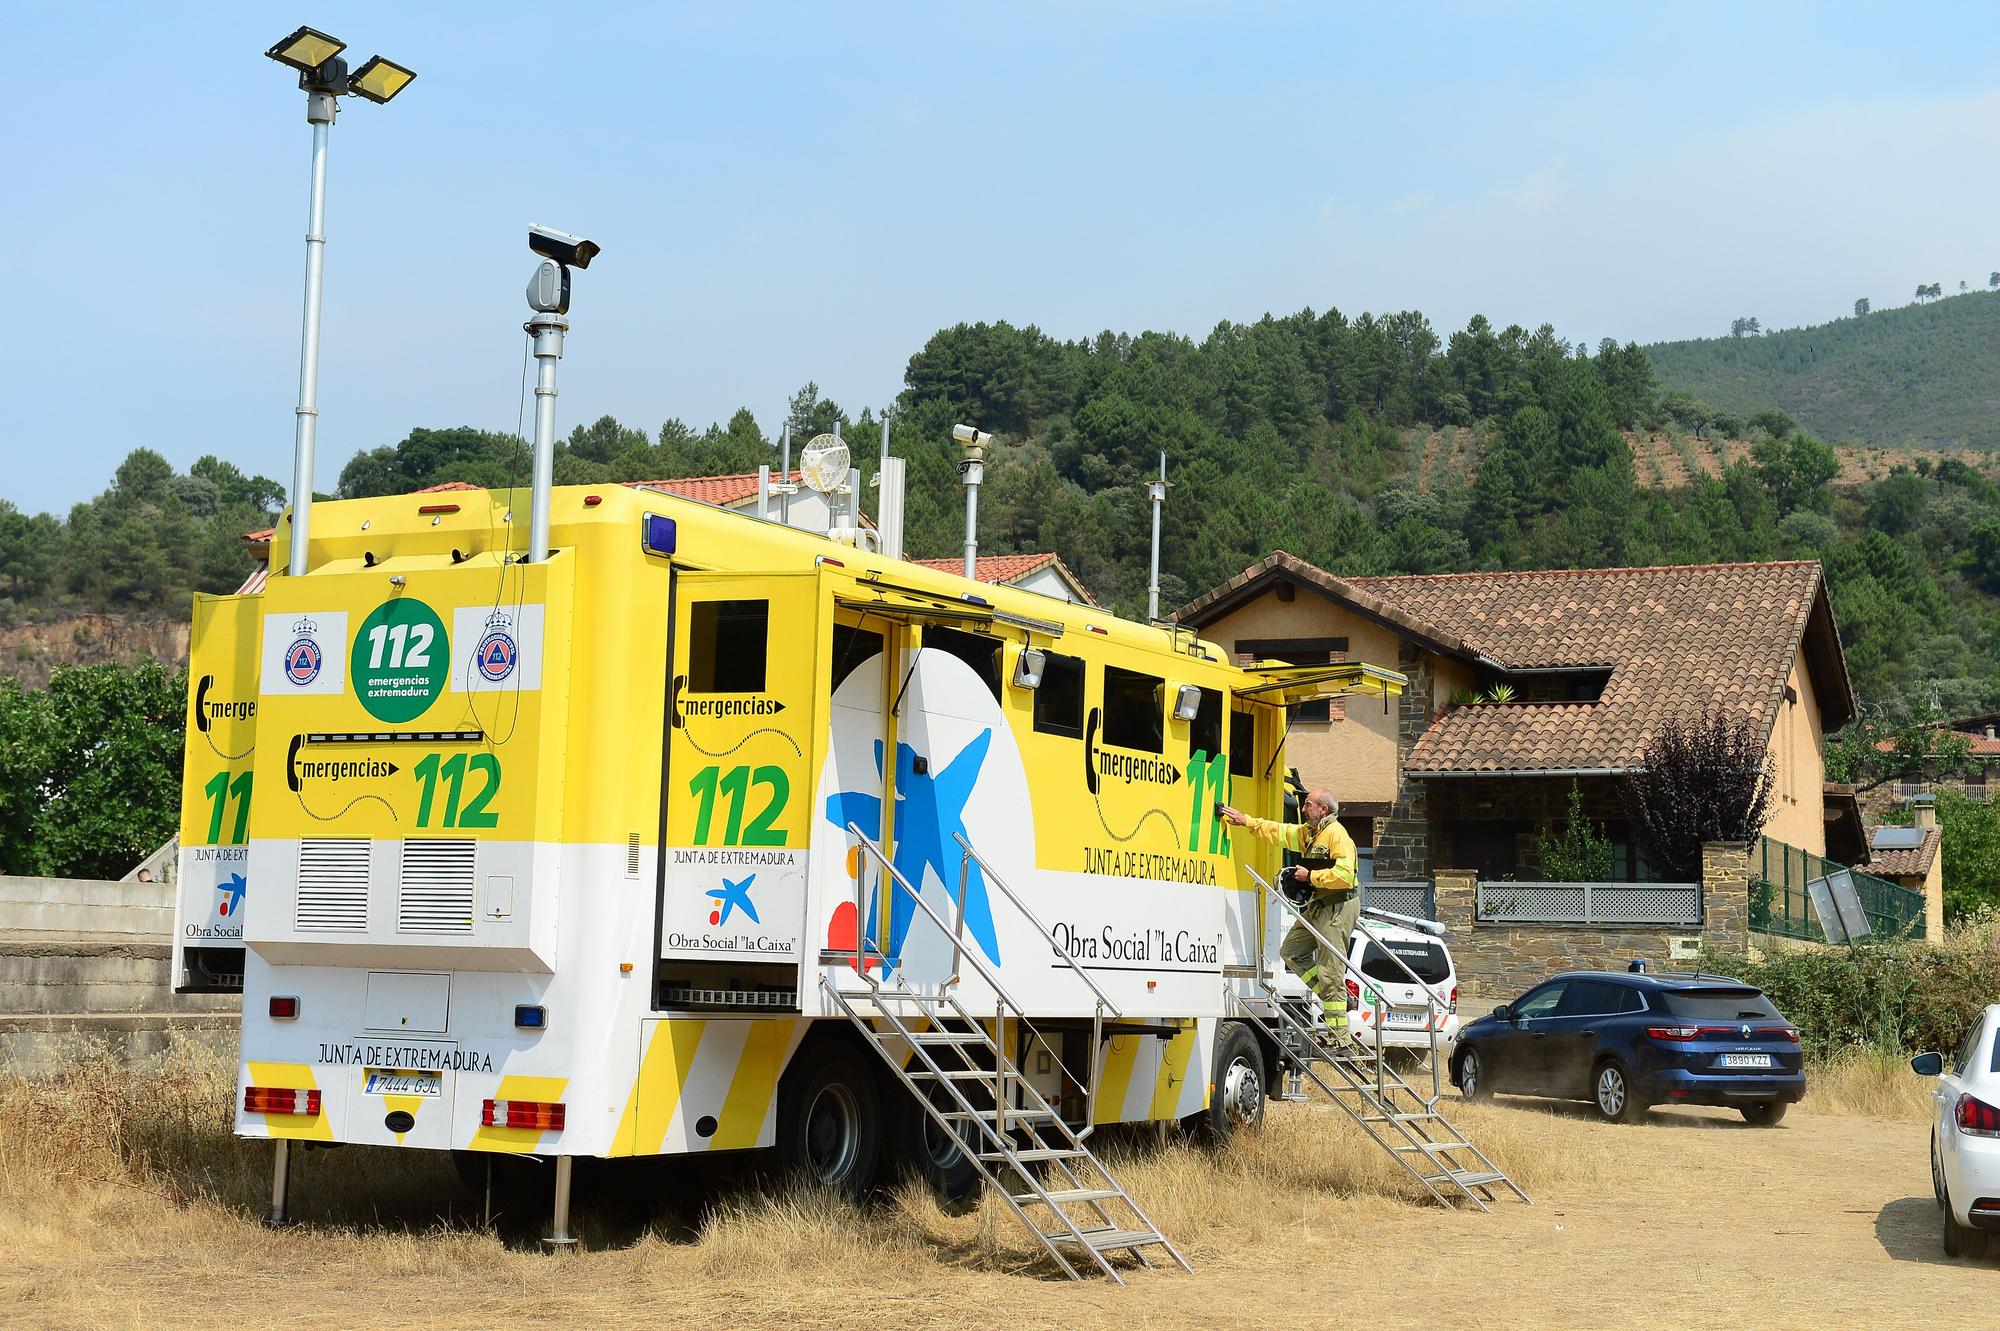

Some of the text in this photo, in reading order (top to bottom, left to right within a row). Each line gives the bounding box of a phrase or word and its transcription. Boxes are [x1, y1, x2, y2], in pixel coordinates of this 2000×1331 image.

[368, 623, 434, 668] 112
[299, 657, 308, 666] 112
[492, 652, 502, 661] 112
[368, 674, 429, 688] emergencias
[367, 686, 429, 697] extremadura
[414, 753, 502, 828] 112
[204, 771, 254, 844] 11
[688, 765, 790, 847] 112
[195, 849, 221, 861] JUNTA
[223, 849, 232, 861] DE
[674, 850, 795, 866] JUNTA DE EXTREMADURA
[1084, 847, 1217, 887] JUNTA DE EXTREMADURA
[186, 923, 243, 937] Obra Social
[668, 933, 700, 948] Obra
[702, 934, 738, 949] Social
[1052, 922, 1097, 959] Obra
[1102, 925, 1150, 961] Social
[319, 1043, 493, 1073] JUNTA DE EXTREMADURA
[1727, 1055, 1769, 1065] 3890 KZZ
[376, 1077, 438, 1094] 7444 GJL
